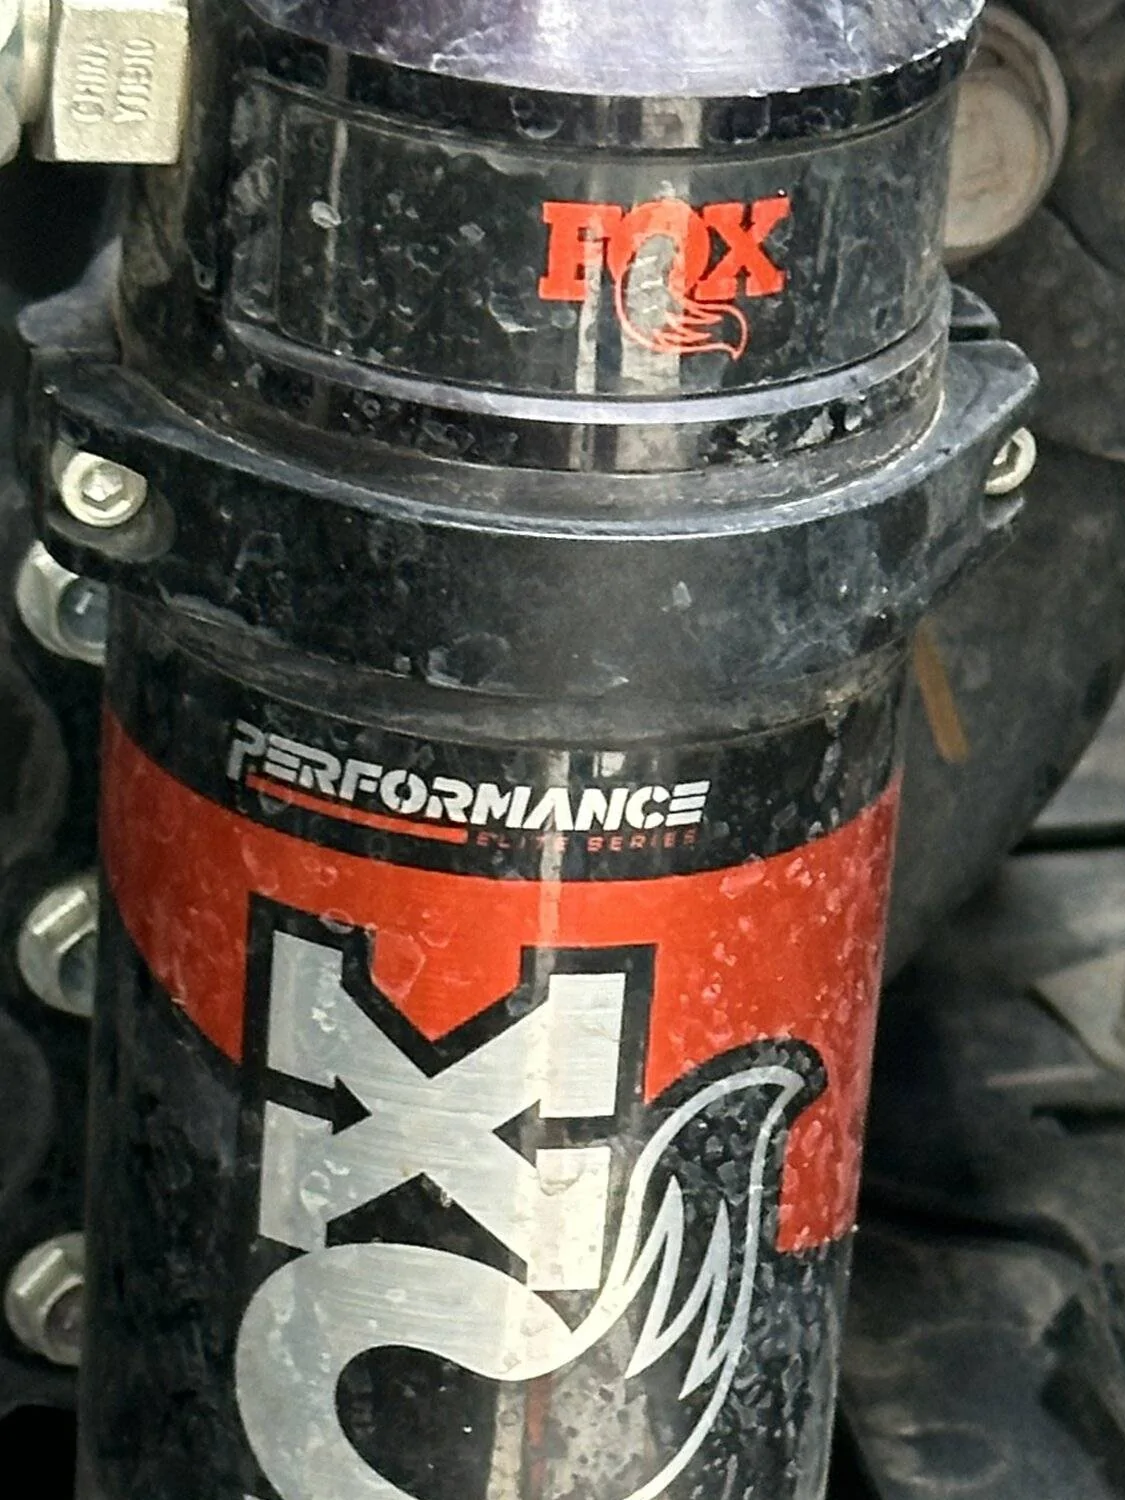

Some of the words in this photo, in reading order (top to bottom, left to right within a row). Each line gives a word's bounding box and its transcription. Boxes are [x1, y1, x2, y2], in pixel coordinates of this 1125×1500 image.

[538, 196, 791, 361] FOX
[225, 718, 711, 832] PERFORMANCE
[586, 829, 698, 853] SERIES
